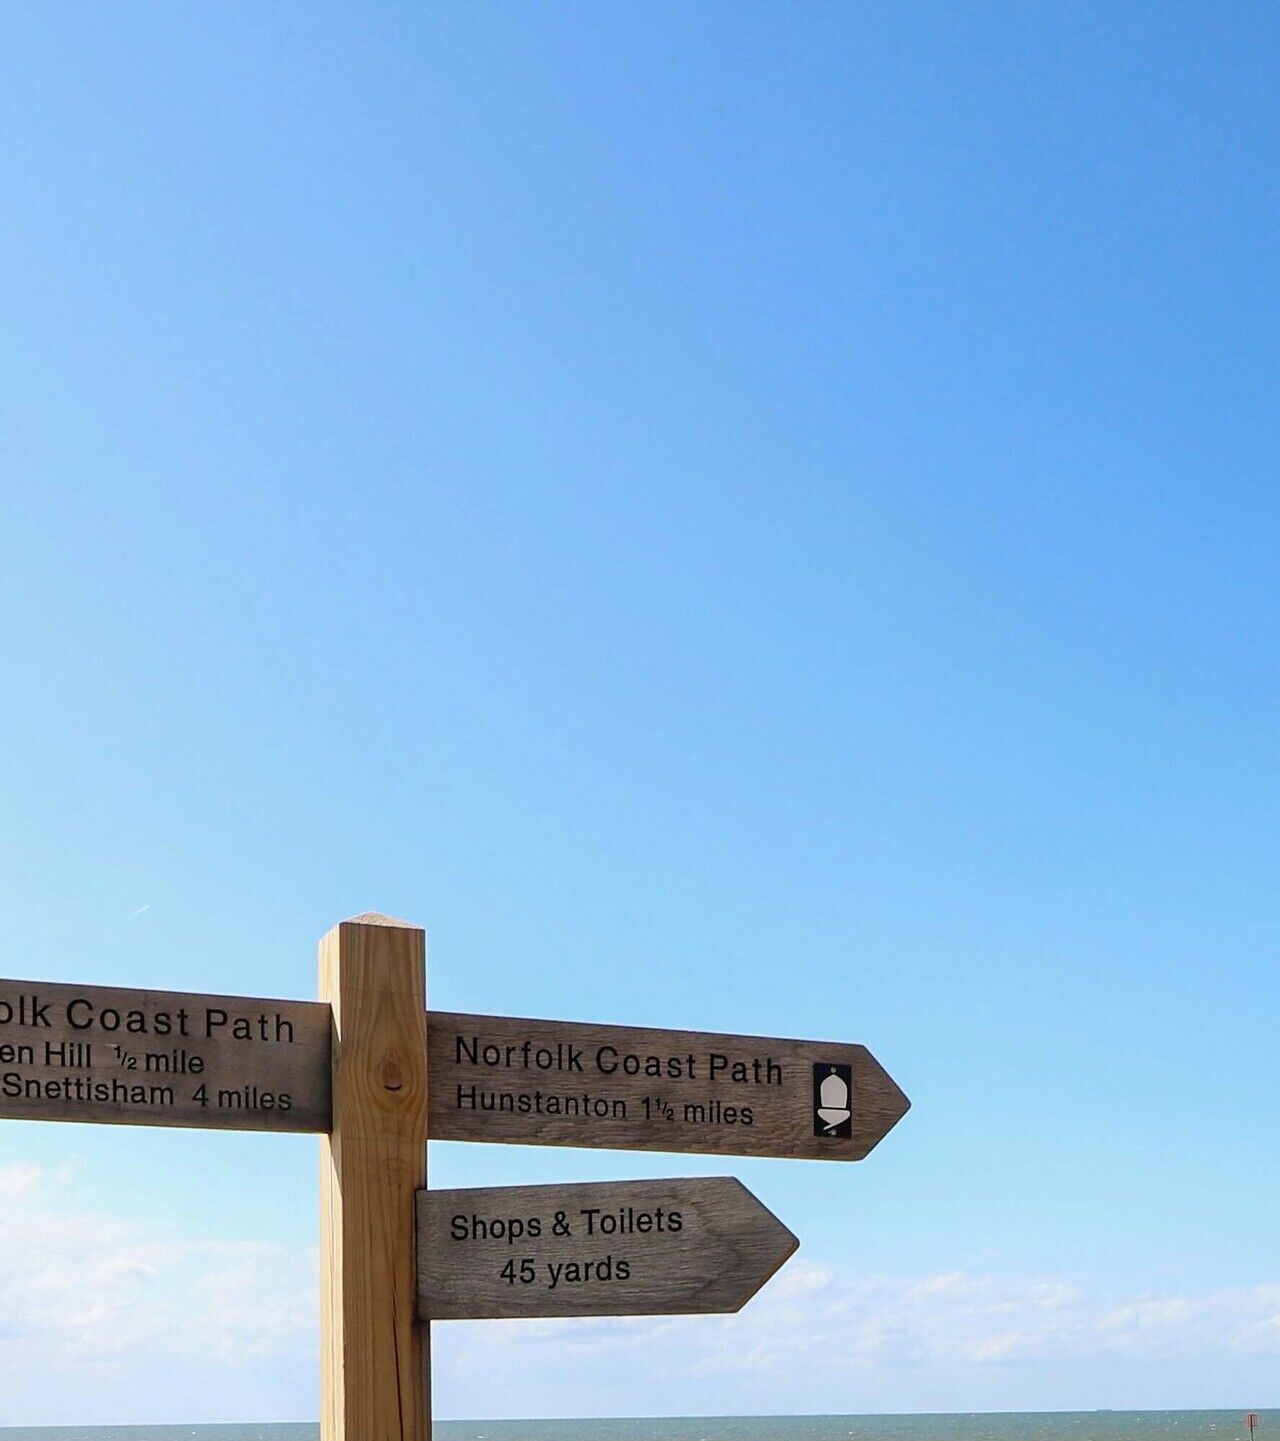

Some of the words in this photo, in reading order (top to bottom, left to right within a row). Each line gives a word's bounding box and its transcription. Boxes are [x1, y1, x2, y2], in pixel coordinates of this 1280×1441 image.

[66, 998, 189, 1036] Coast
[205, 1008, 294, 1043] Path
[45, 1040, 93, 1069] Hill
[145, 1048, 205, 1074] mile
[455, 1035, 585, 1073] Norfolk
[595, 1045, 697, 1080] Coast
[709, 1053, 783, 1086] Path
[2, 1072, 174, 1105] Snettisham
[191, 1084, 209, 1108] 4
[218, 1086, 293, 1112] miles
[456, 1085, 627, 1119] Hunstanton
[683, 1100, 754, 1126] miles
[450, 1212, 542, 1245] Shops
[551, 1211, 573, 1238] &
[580, 1207, 683, 1235] Toilets
[499, 1259, 536, 1285] 45
[547, 1255, 631, 1289] yards
